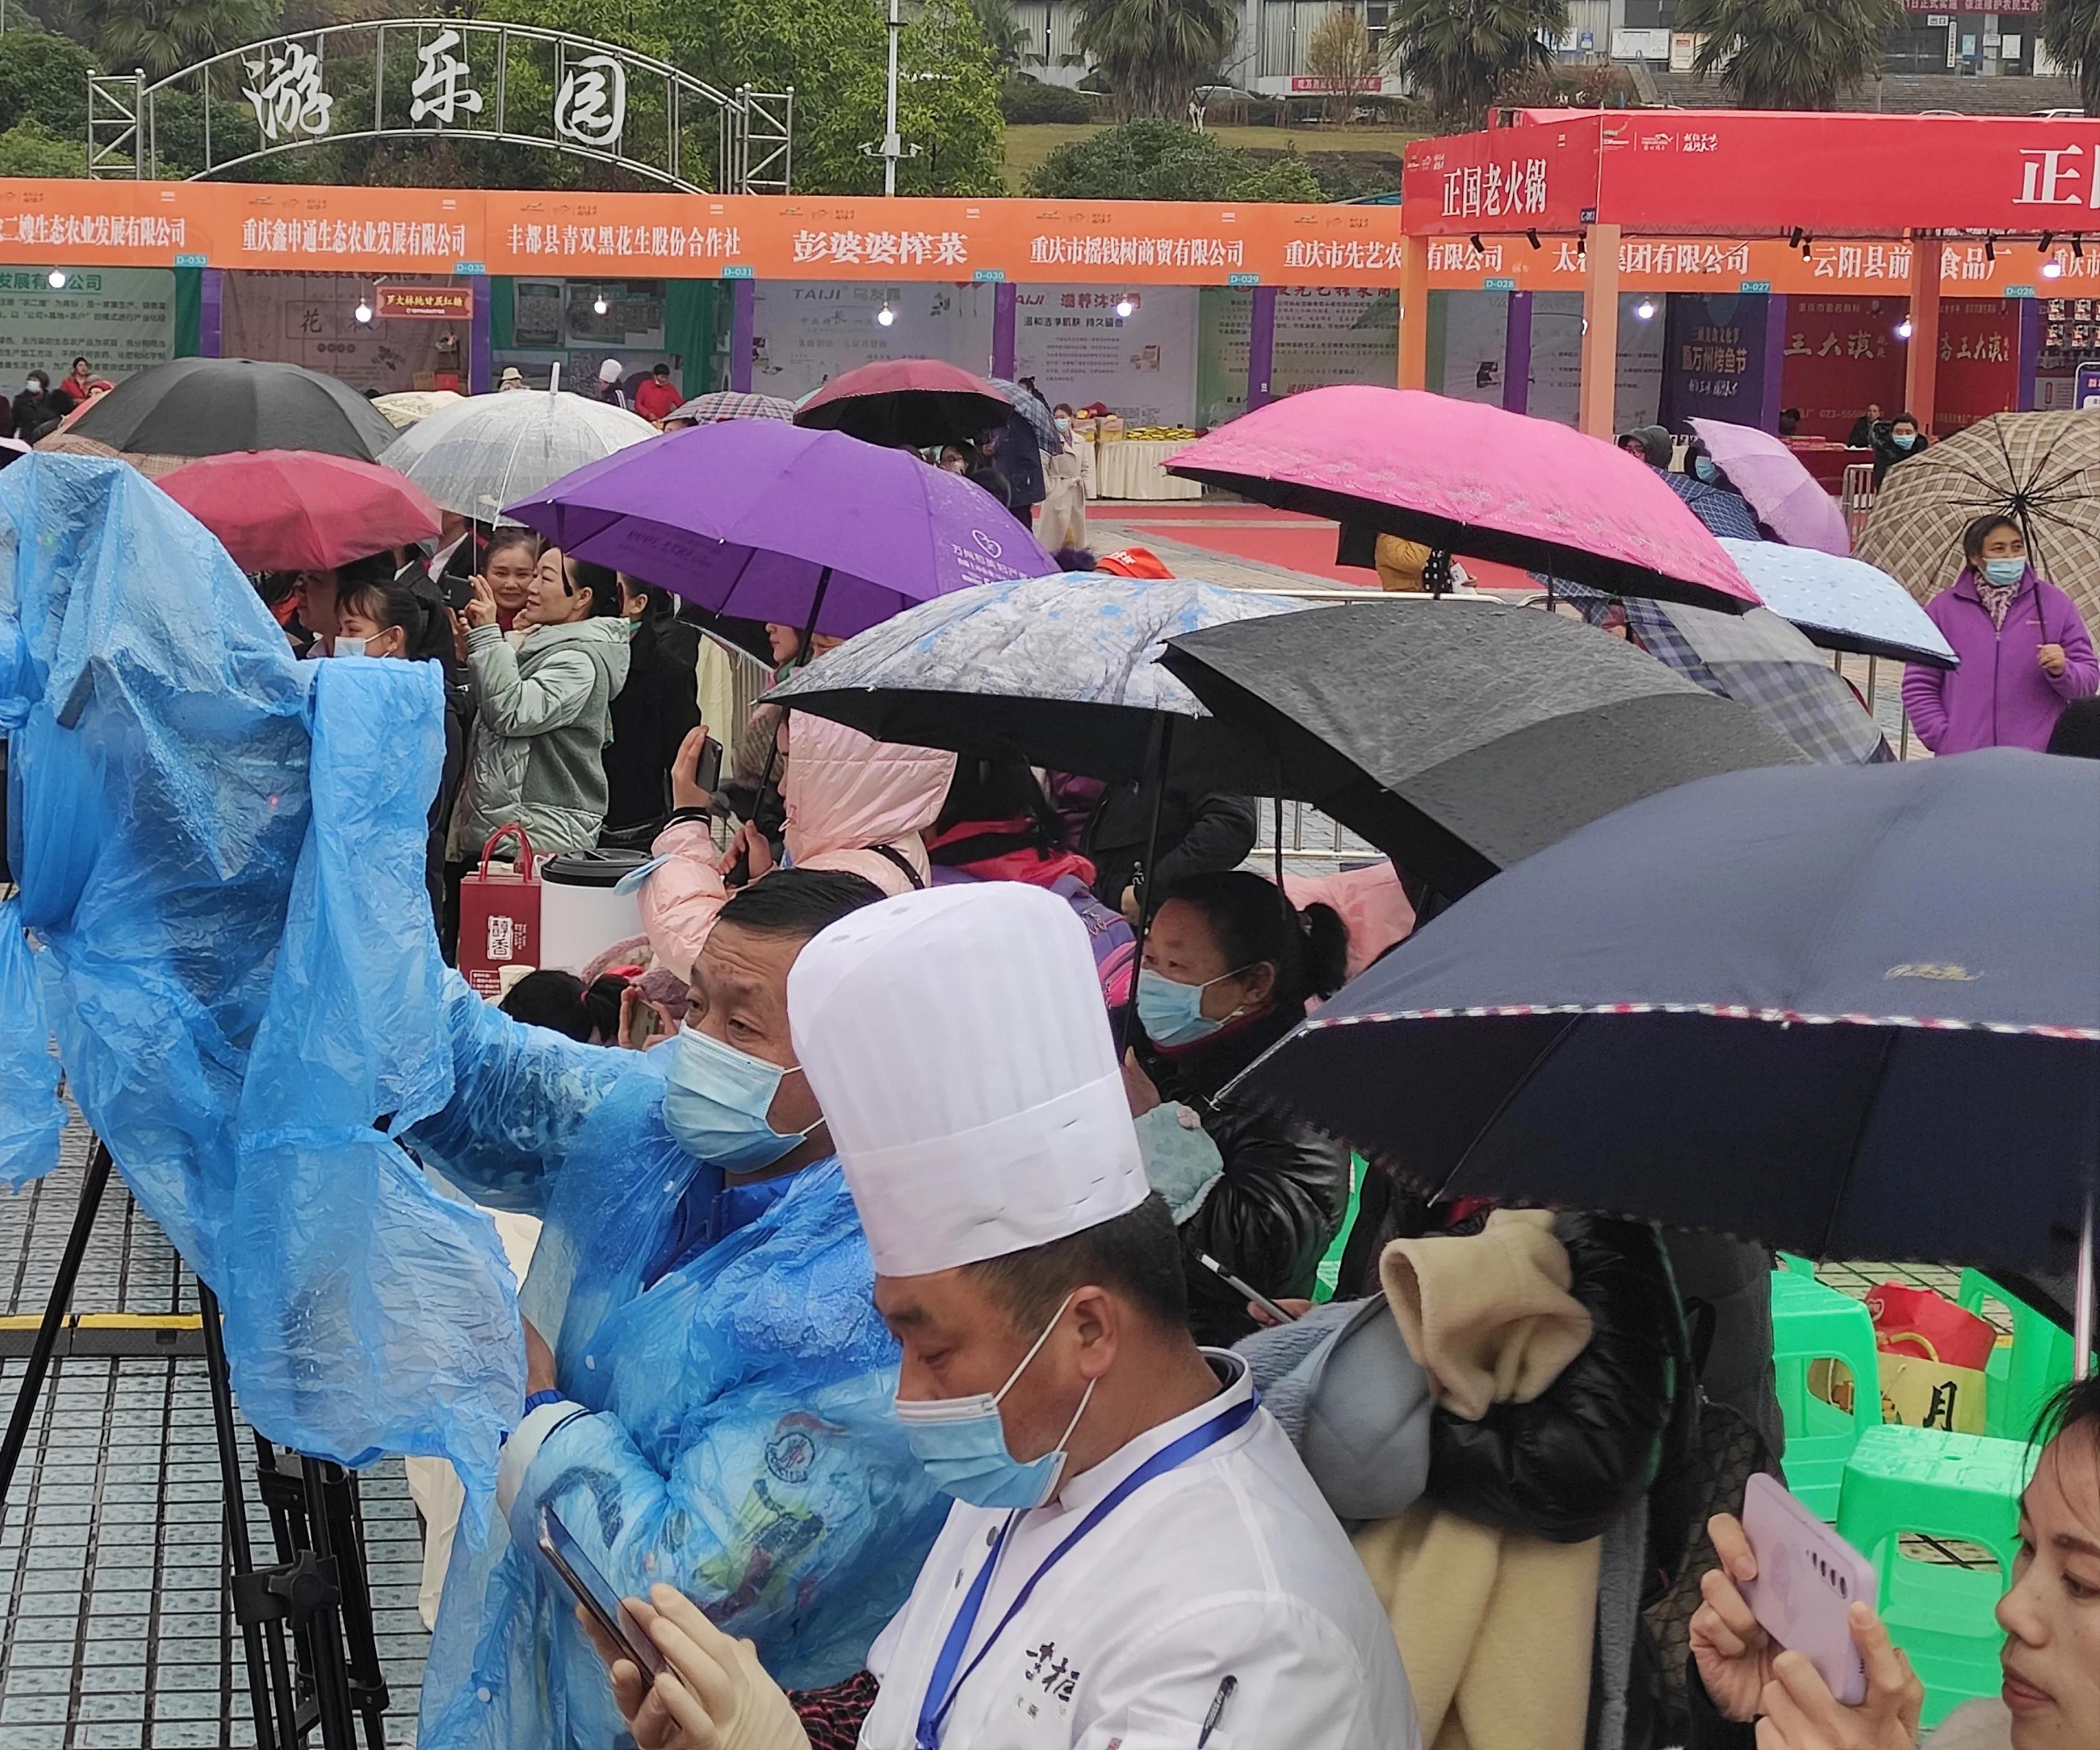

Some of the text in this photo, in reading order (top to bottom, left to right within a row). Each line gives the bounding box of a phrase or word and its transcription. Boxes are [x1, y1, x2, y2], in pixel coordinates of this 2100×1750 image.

[242, 30, 625, 145] 游乐园
[1442, 157, 1546, 218] 正国老火锅
[2012, 144, 2100, 209] 正
[241, 218, 465, 256] 重庆鑫申通生态农业发展有限公司
[507, 223, 741, 257] 丰都县青双黑花生股份合作社
[792, 229, 968, 265] 彭婆婆榨菜
[1030, 235, 1243, 267] 重庆市摇钱树商贸有限公司
[175, 255, 207, 265] D-033
[724, 267, 752, 277] D-031
[1283, 239, 1503, 273] 重庆市先艺农有限公司
[1552, 242, 1749, 275] 太团有限公司
[1813, 246, 2013, 280] 云阳县前食品厂
[0, 273, 102, 291] 发展有公司
[975, 270, 1004, 280] D-030
[1230, 275, 1260, 284] D-029
[1485, 280, 1515, 289] D-028
[1742, 283, 1770, 291] D-027
[2006, 286, 2035, 296] D-026
[793, 289, 841, 300] TAIJI
